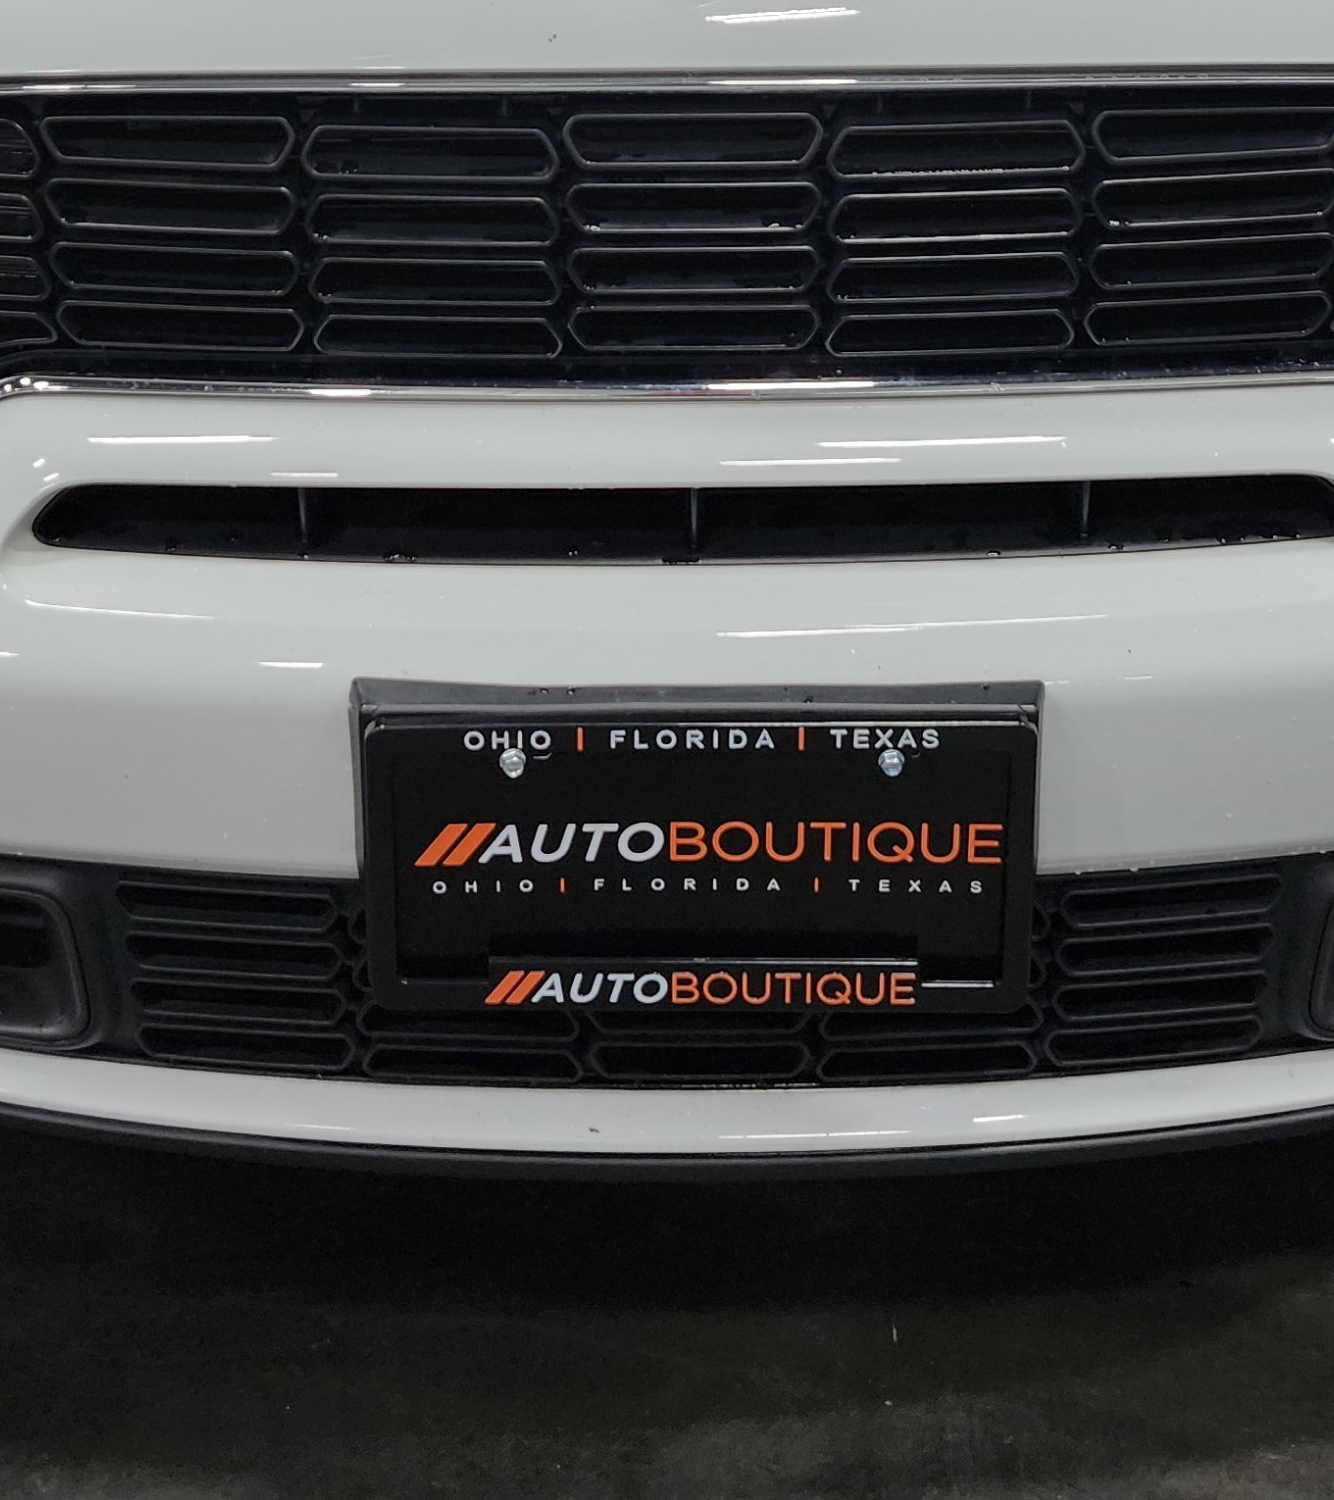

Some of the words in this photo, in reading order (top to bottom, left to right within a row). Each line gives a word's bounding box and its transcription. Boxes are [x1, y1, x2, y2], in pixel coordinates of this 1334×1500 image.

[463, 729, 551, 751] OHIO
[609, 728, 775, 750] FLORIDA
[829, 728, 940, 749] TEXAS
[477, 821, 1004, 864] AUTOBOUTIQUE
[431, 879, 534, 894] OHIO
[593, 878, 781, 892] FLORIDA
[848, 879, 983, 894] TEXAS
[530, 971, 916, 1005] AUTOBOUTIQUE
